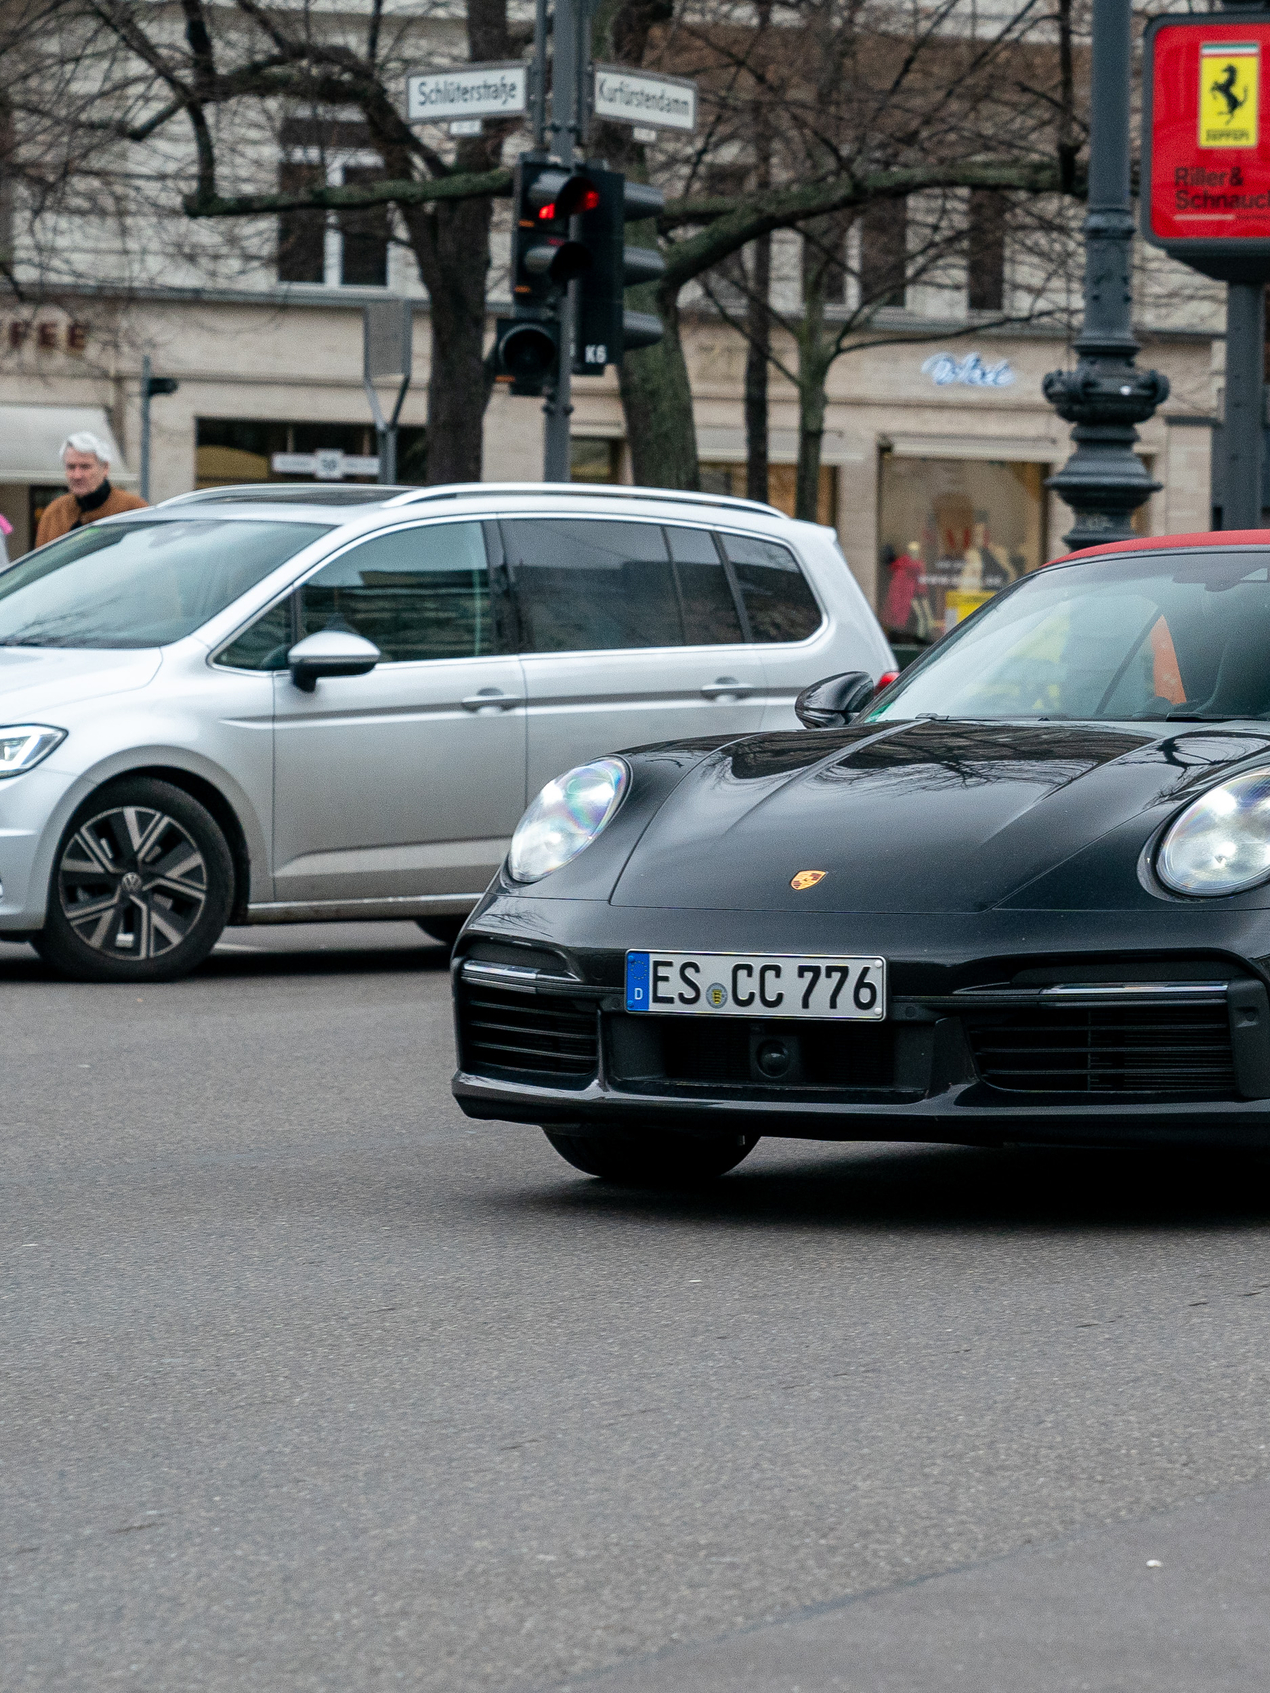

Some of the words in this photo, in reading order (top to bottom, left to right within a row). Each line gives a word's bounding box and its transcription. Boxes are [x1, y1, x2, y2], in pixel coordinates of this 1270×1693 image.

[599, 79, 690, 116] Kurfürstendamm
[585, 344, 606, 363] K6
[634, 988, 643, 1000] D
[652, 960, 701, 1005] ES
[731, 963, 784, 1007] CC
[798, 965, 877, 1010] 776
